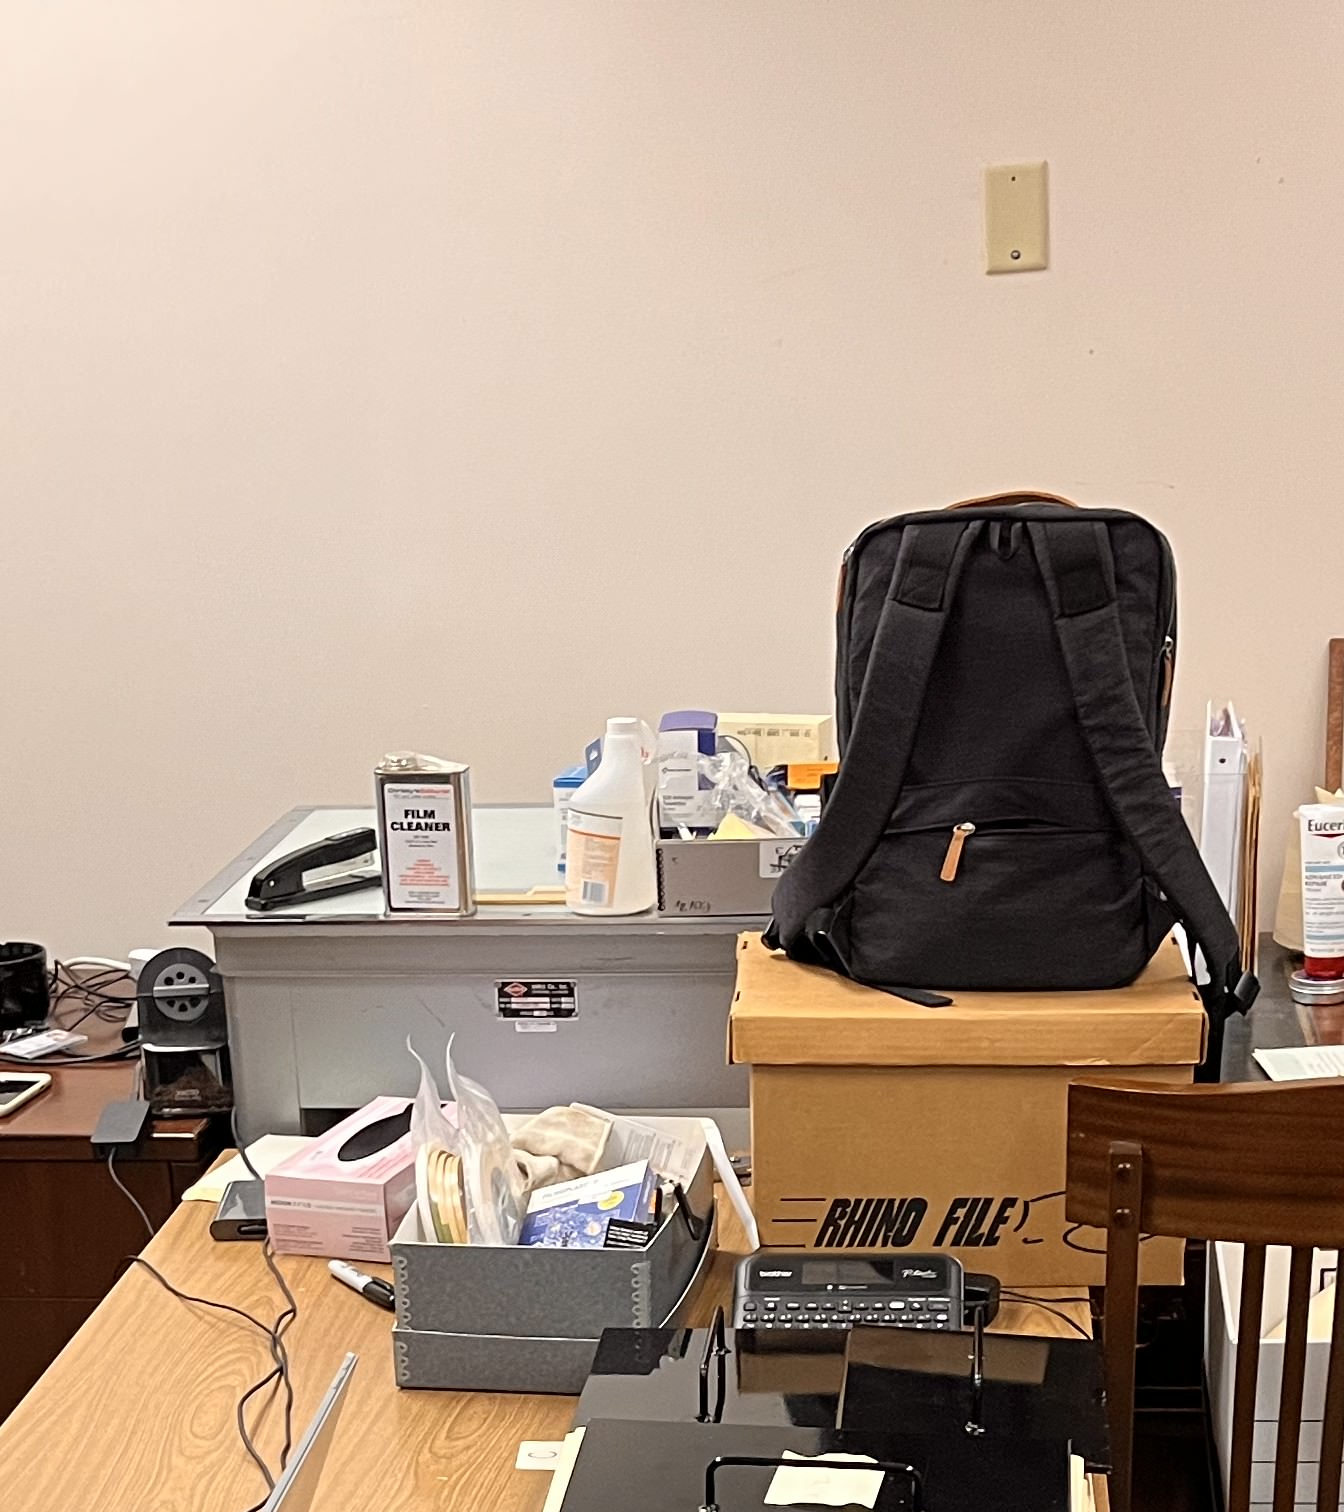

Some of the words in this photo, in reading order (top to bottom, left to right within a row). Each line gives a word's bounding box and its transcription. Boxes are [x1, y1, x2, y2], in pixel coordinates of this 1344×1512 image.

[404, 809, 436, 819] FILM
[390, 821, 451, 832] CLEANER
[814, 1197, 928, 1248] RHINO
[932, 1197, 1019, 1247] FILE
